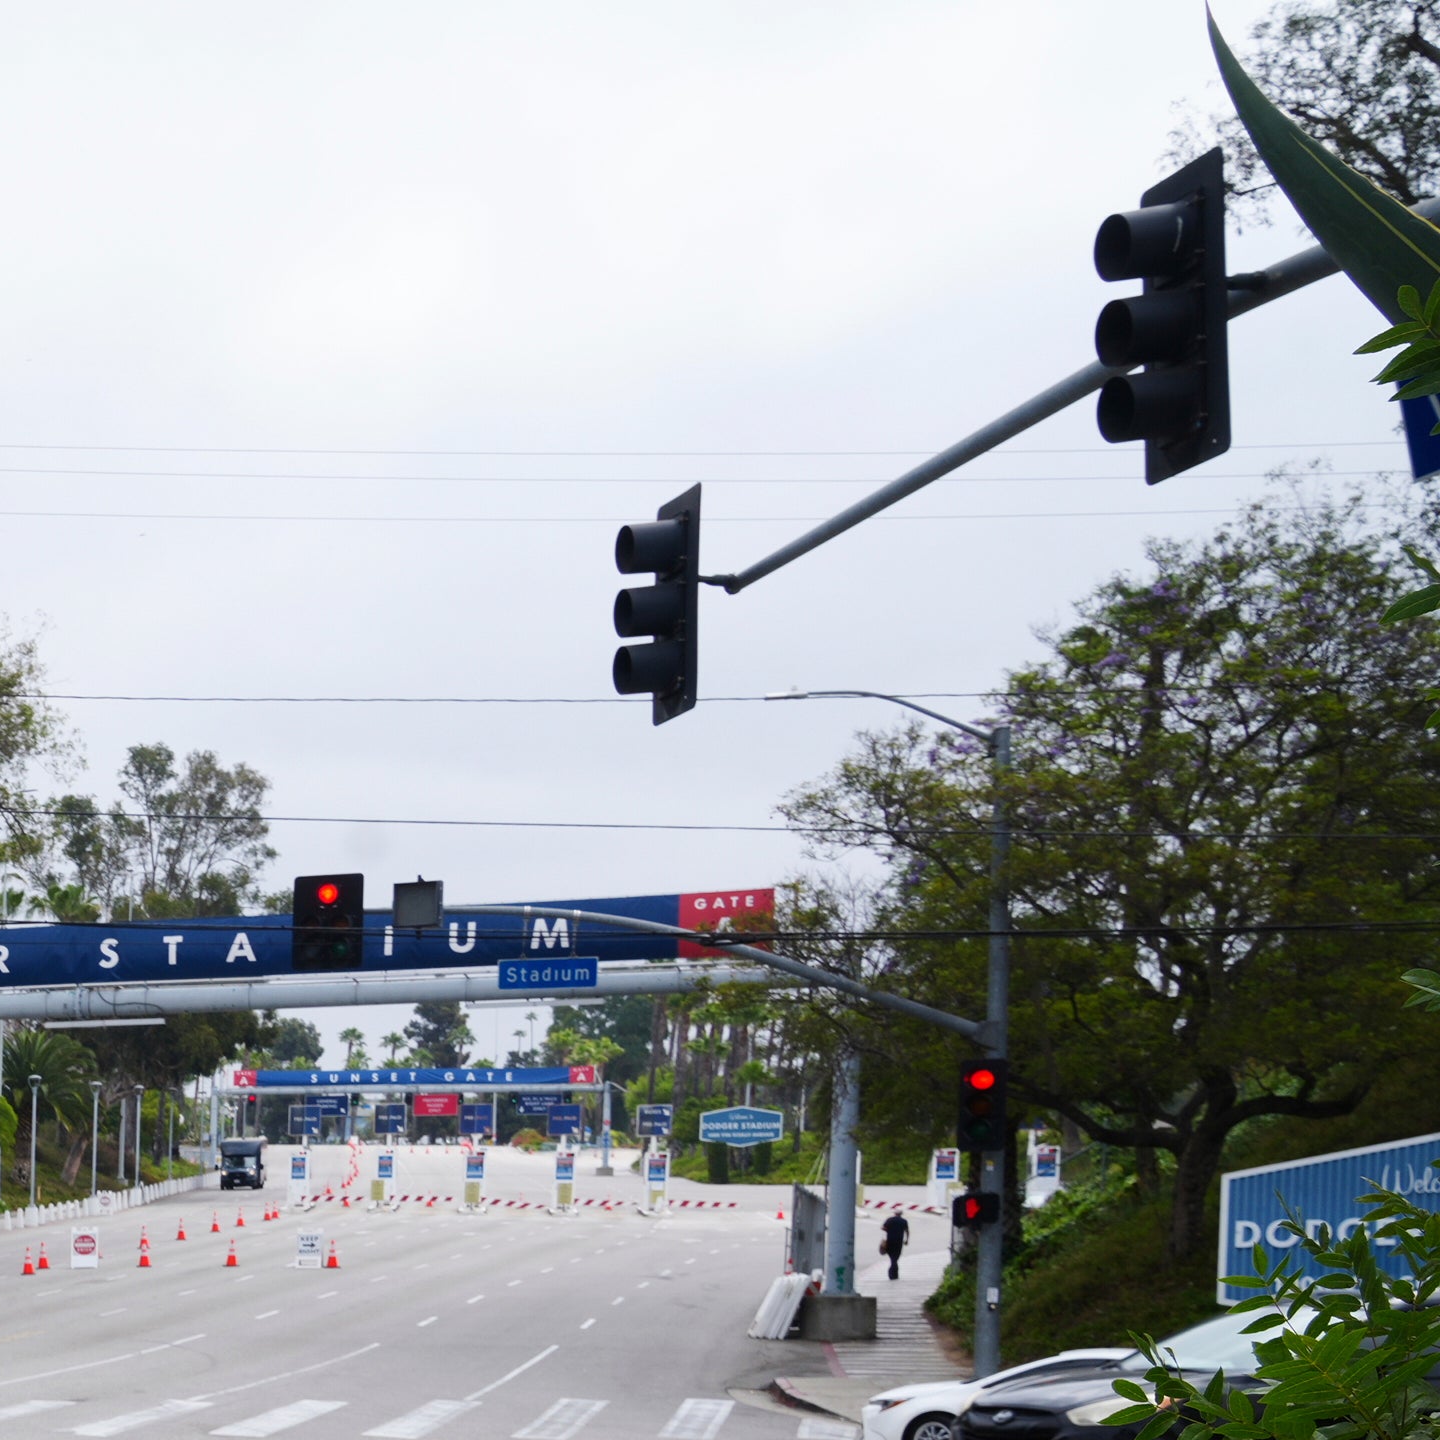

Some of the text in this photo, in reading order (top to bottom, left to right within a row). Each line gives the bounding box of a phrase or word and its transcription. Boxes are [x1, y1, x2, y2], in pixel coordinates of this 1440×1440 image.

[693, 894, 755, 911] GATE
[99, 917, 570, 970] STAIUM
[506, 964, 591, 984] Stadium
[239, 1076, 249, 1085] A
[310, 1071, 513, 1083] SUNSET GATE
[576, 1072, 587, 1082] A
[703, 1122, 780, 1130] DODGER STADIUM
